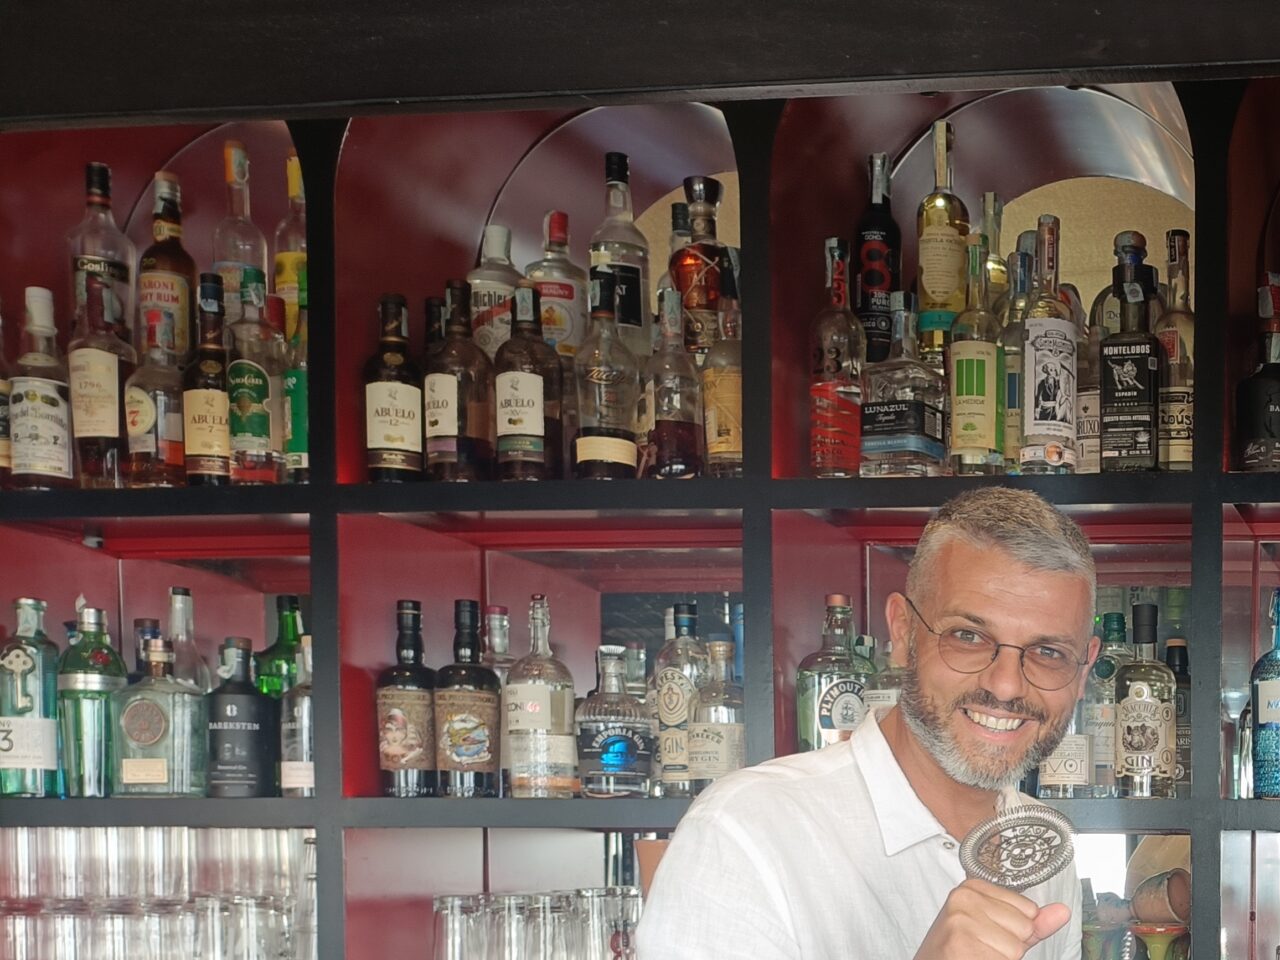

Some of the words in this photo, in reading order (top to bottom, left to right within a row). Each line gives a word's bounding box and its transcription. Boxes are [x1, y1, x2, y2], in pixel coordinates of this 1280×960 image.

[1103, 344, 1151, 357] MONTELOBOS
[500, 399, 535, 410] ABUELO
[864, 403, 909, 414] LUNAZUL
[373, 407, 416, 420] ABUELO
[0, 729, 14, 752] 3
[591, 727, 633, 749] EMPORIA
[1124, 755, 1154, 768] GIN
